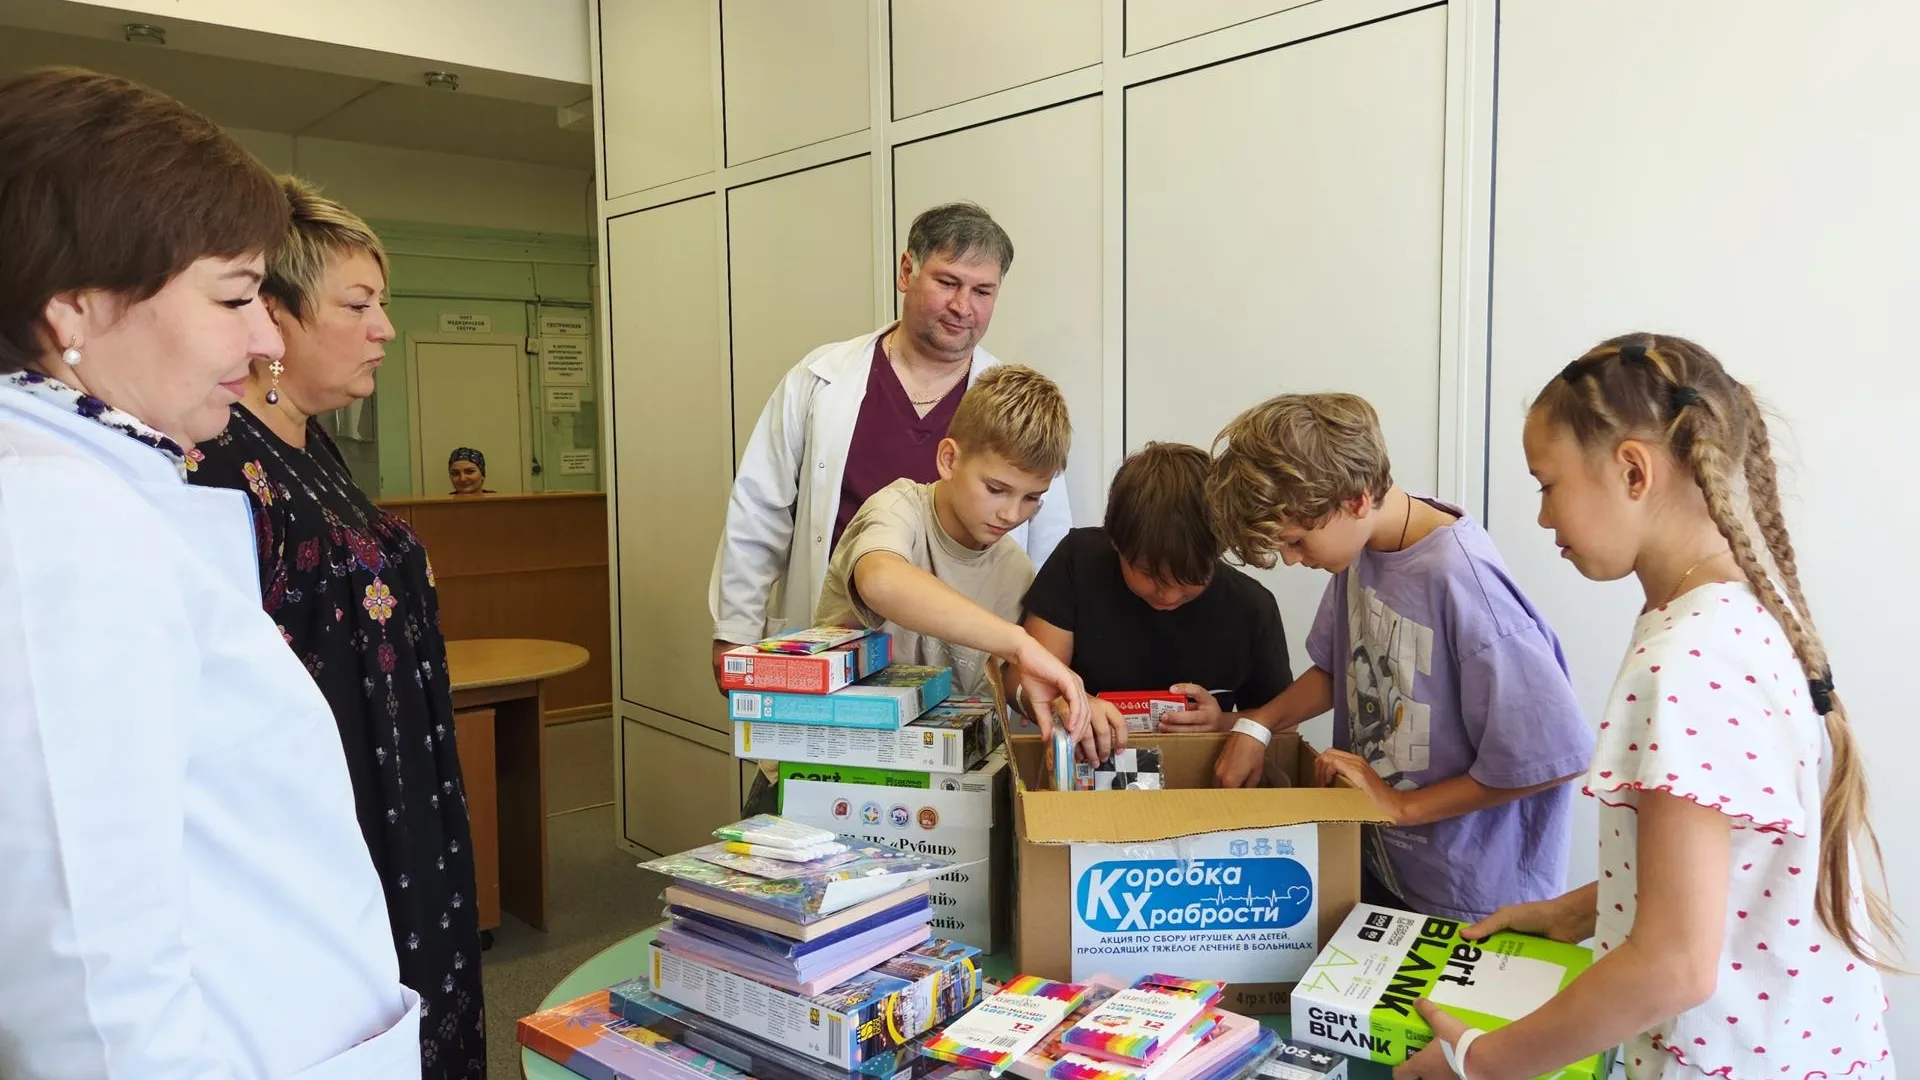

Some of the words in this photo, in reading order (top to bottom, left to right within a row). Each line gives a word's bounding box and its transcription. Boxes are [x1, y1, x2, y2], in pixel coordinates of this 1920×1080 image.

[889, 838, 957, 857] «Рубин»
[1085, 861, 1242, 920] Коробка
[1117, 892, 1279, 930] Храбрости
[1100, 936, 1133, 944] АКЦИЯ
[1190, 934, 1233, 942] ИГРУШЕК
[1236, 933, 1256, 941] ДЛЯ
[1077, 945, 1149, 955] ПРОХОДЯЩИХ
[1152, 944, 1197, 953] ТЯЖЁЛОЕ
[1200, 943, 1241, 951] ЛЕЧЕНИЕ
[1243, 943, 1250, 951] В
[1252, 942, 1313, 950] БОЛЬНИЦАХ
[1301, 943, 1358, 992] A4
[1236, 991, 1243, 1004] 4
[1246, 995, 1257, 1007] гр
[1269, 991, 1287, 1004] 100
[1013, 1022, 1034, 1032] 12
[1143, 1019, 1165, 1030] 12
[1308, 1007, 1358, 1030] cart
[1310, 1020, 1391, 1056] BLANK
